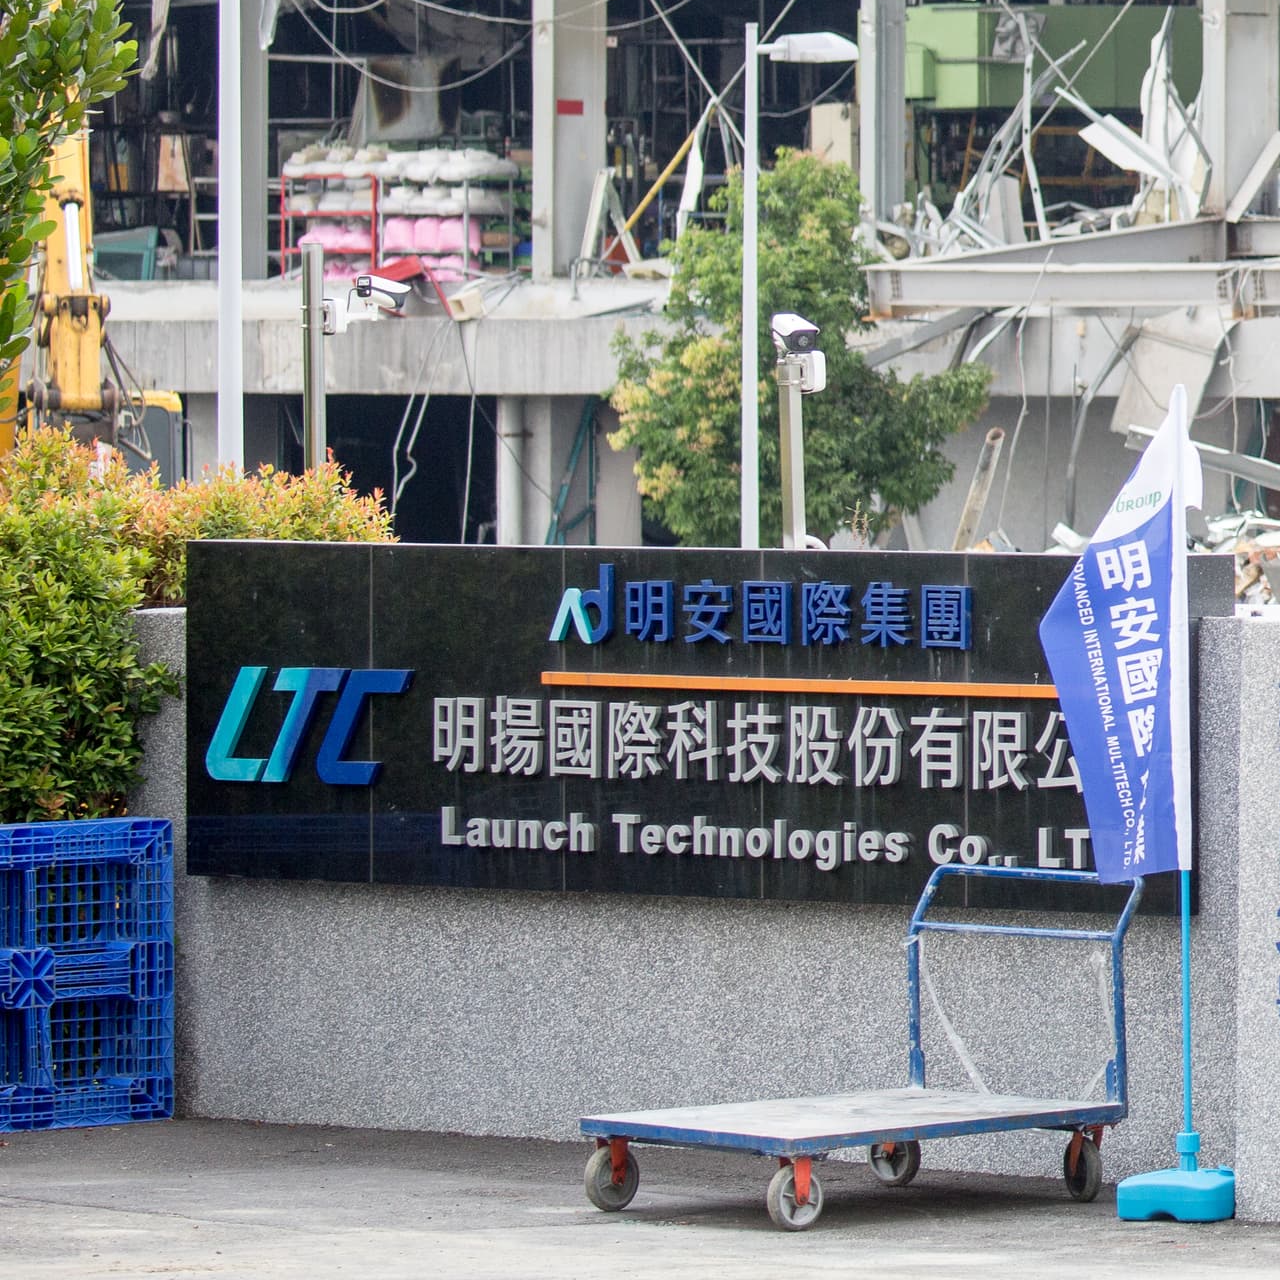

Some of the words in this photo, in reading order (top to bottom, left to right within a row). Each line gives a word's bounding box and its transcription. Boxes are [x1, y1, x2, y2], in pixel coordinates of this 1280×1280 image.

[624, 579, 972, 648] 明安國際集團
[1083, 629, 1115, 732] INTERNATIONAL
[205, 666, 415, 785] LTC
[433, 695, 1084, 793] 明揚國際科技股份有限公
[1106, 735, 1134, 807] MULTITECH
[440, 806, 595, 852] Launch
[612, 813, 912, 871] Technologies
[927, 824, 1018, 869] Co.,
[1037, 827, 1092, 870] LT
[1122, 809, 1136, 836] CO.,
[1122, 842, 1134, 870] LTD.
